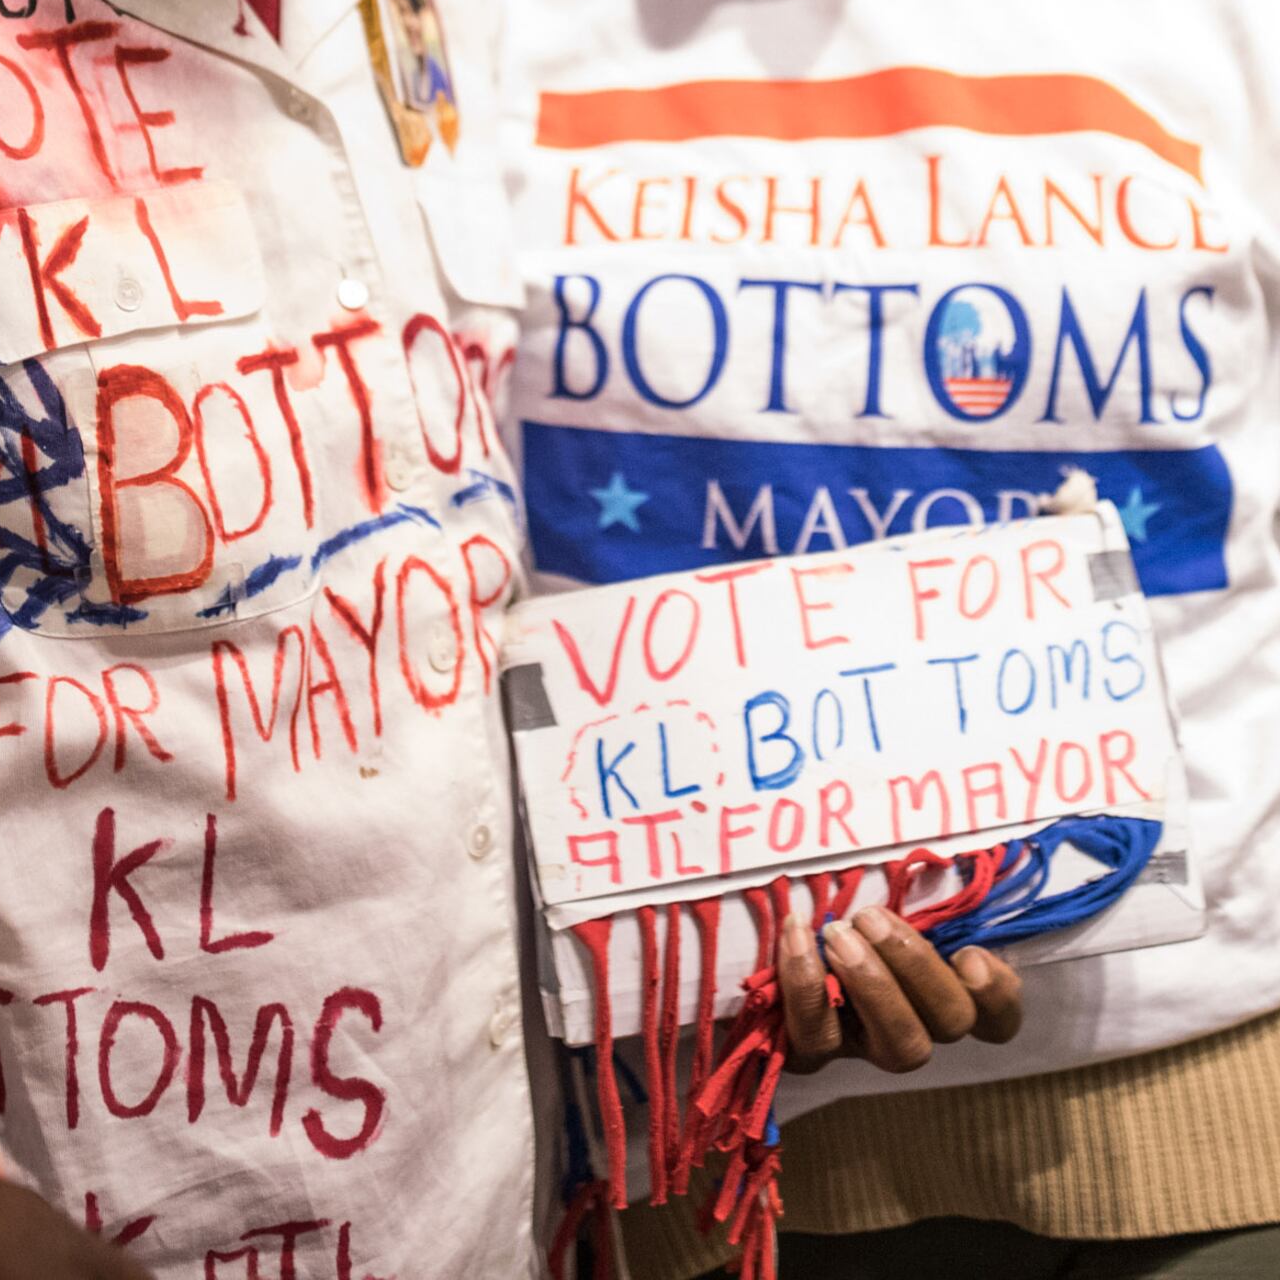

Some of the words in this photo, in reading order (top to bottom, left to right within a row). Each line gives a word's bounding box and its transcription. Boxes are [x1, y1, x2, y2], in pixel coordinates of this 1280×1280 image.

[15, 199, 224, 351] KL
[561, 167, 889, 250] KEISHA
[548, 273, 1217, 425] BOTTOMS
[211, 534, 511, 802] MAYOR
[552, 563, 855, 706] VOTE
[908, 539, 1072, 641] FOR
[596, 721, 702, 819] KL
[719, 780, 860, 873] FOR
[888, 730, 1151, 847] MAYOR
[89, 806, 276, 972] KL
